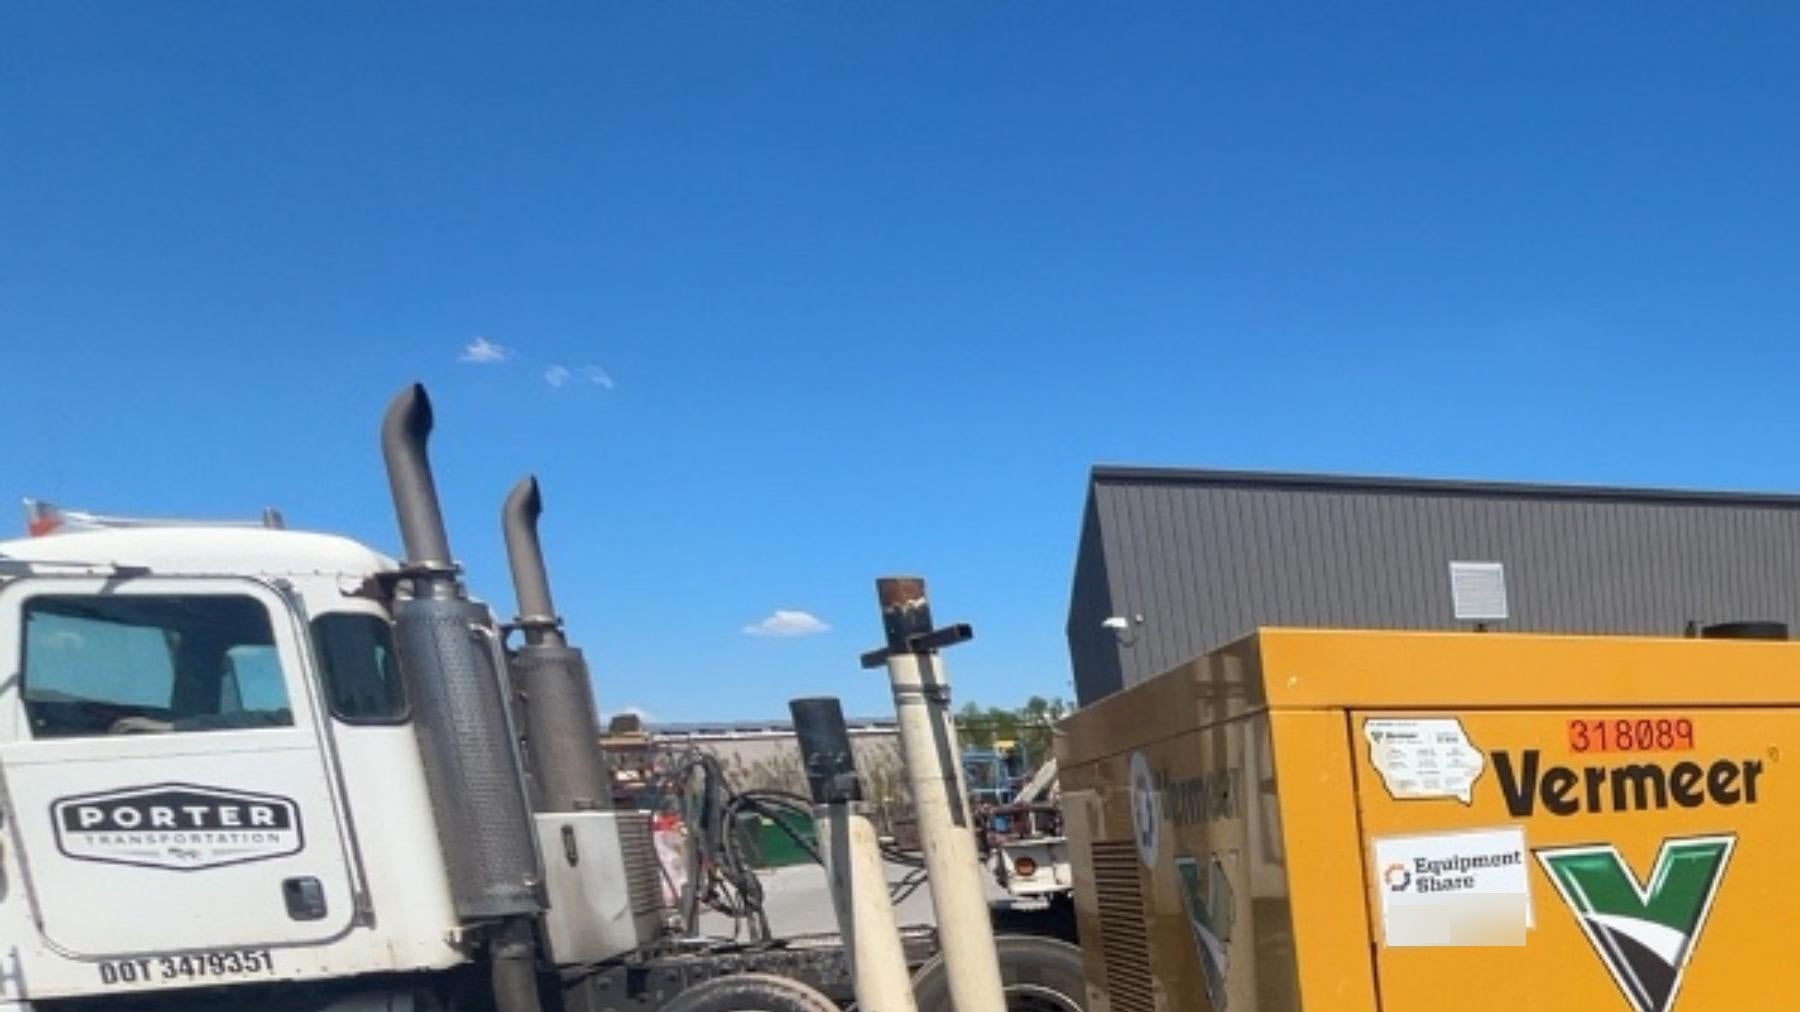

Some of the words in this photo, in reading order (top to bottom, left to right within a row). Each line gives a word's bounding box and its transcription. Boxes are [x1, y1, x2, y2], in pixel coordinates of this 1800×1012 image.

[1569, 718, 1694, 752] 318089
[1491, 749, 1763, 817] Vermeer
[78, 805, 275, 828] PORTER
[85, 833, 280, 846] TRANSPORTATION
[1413, 851, 1521, 875] Equipment
[1415, 876, 1475, 893] Share
[100, 959, 153, 984] DOT
[162, 950, 274, 979] 3479351
